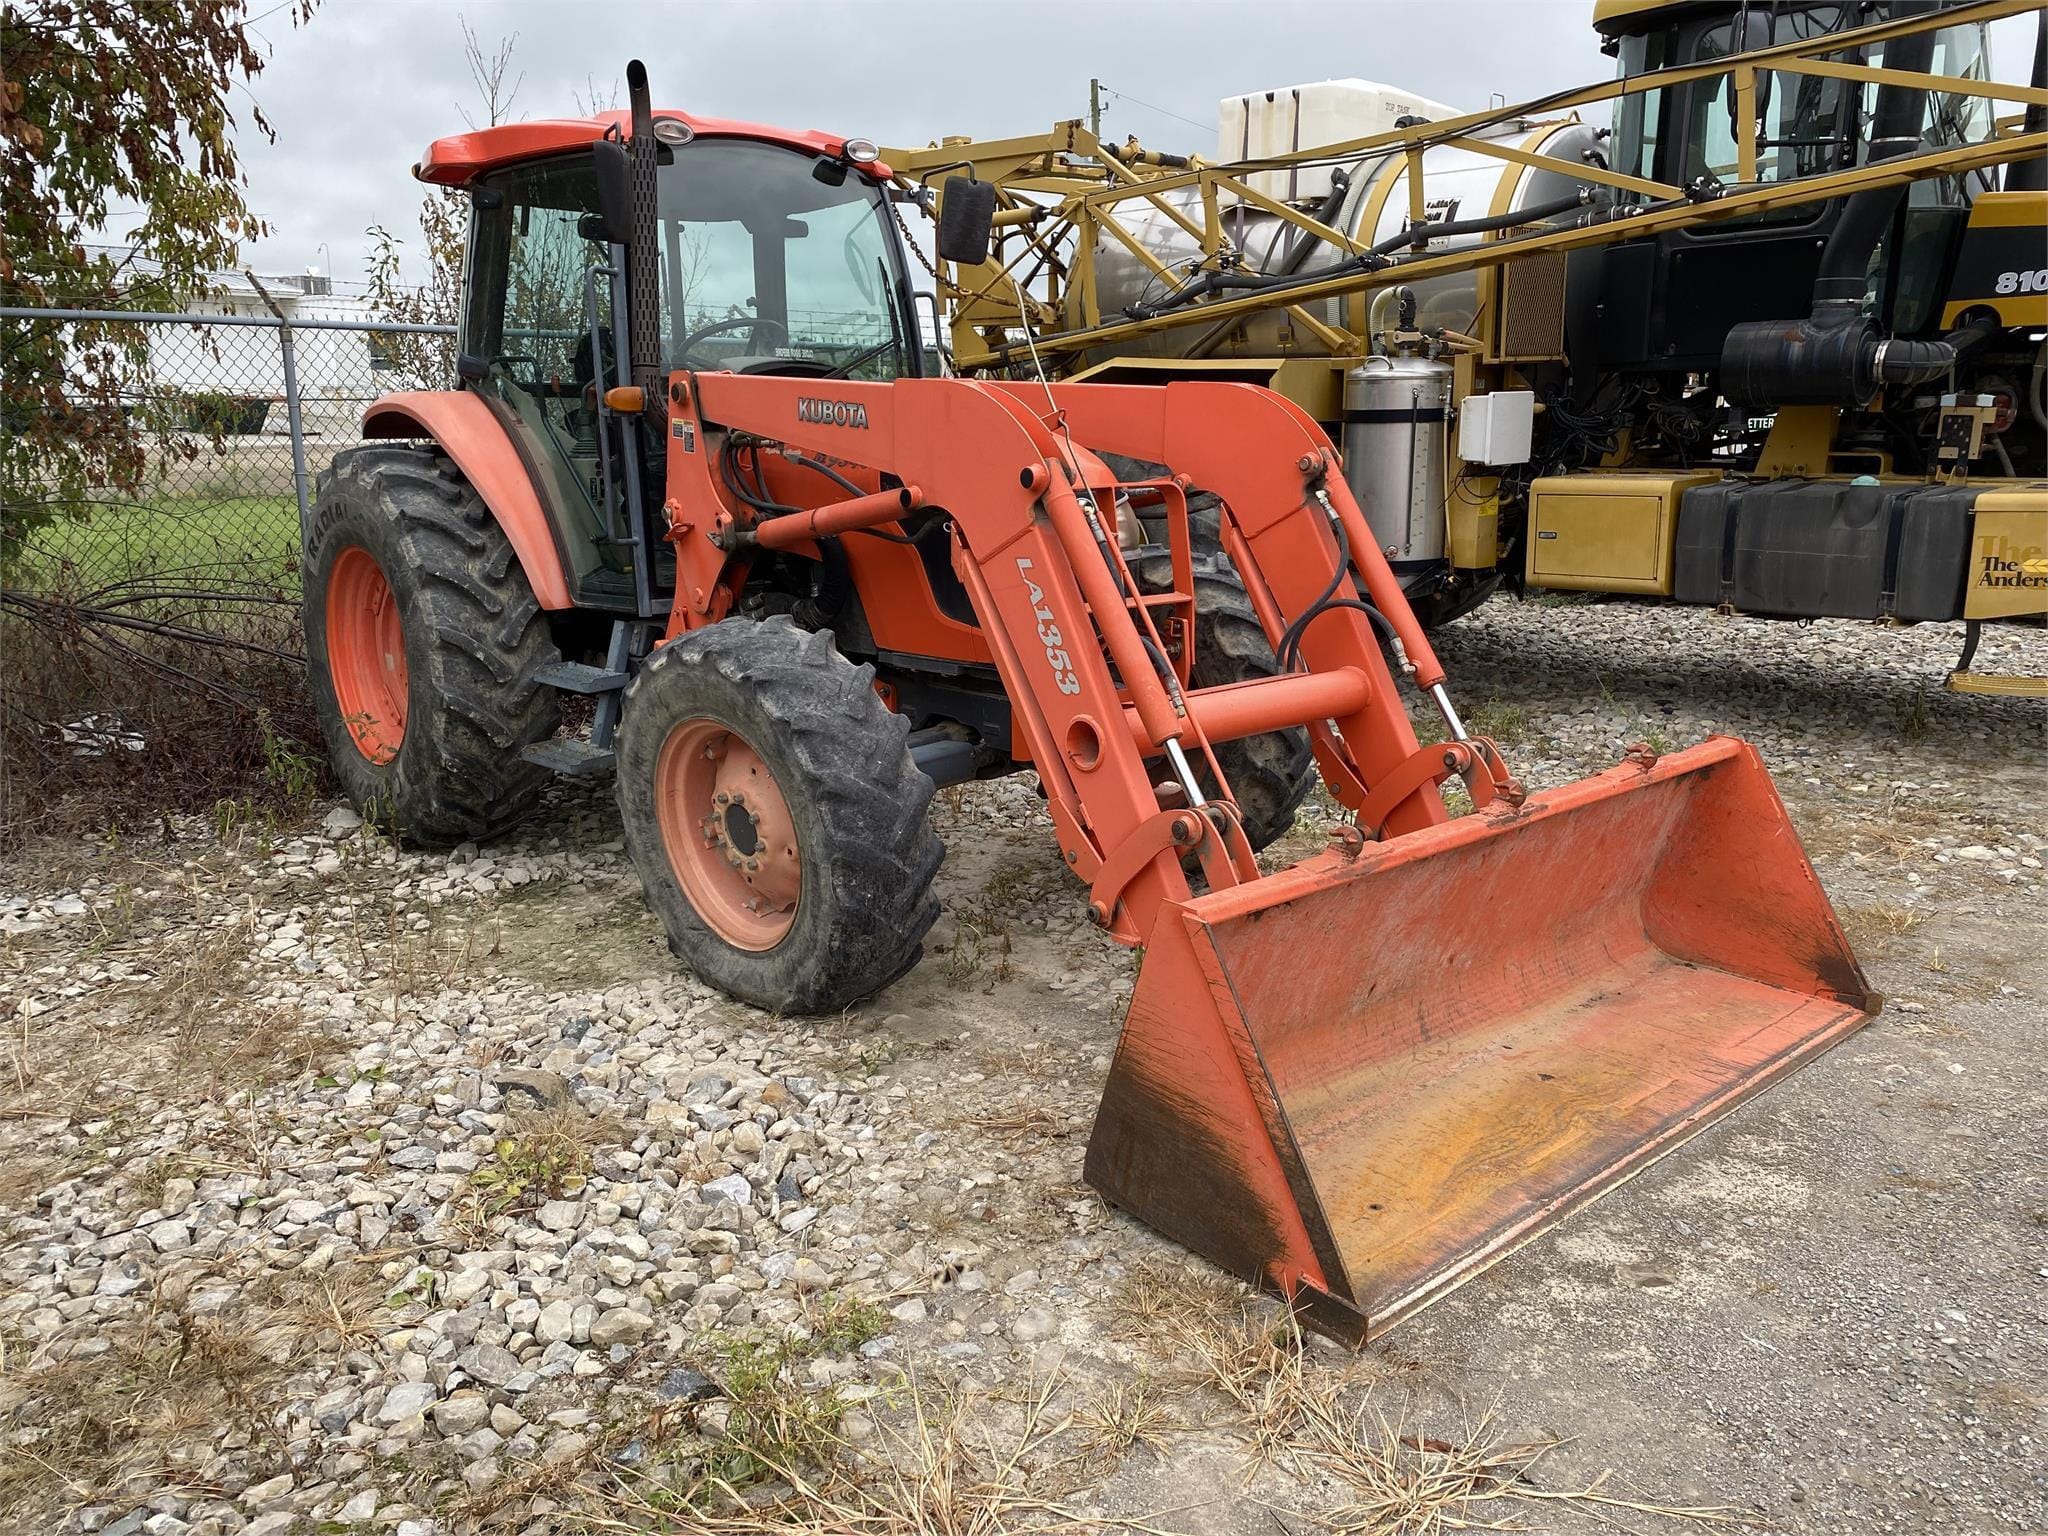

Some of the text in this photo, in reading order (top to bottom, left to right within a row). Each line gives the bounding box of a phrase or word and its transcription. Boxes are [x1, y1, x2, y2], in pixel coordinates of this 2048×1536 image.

[1995, 270, 2048, 294] 810
[797, 396, 869, 429] KUBOTA
[1981, 556, 2019, 572] The
[1015, 557, 1082, 696] LA1353
